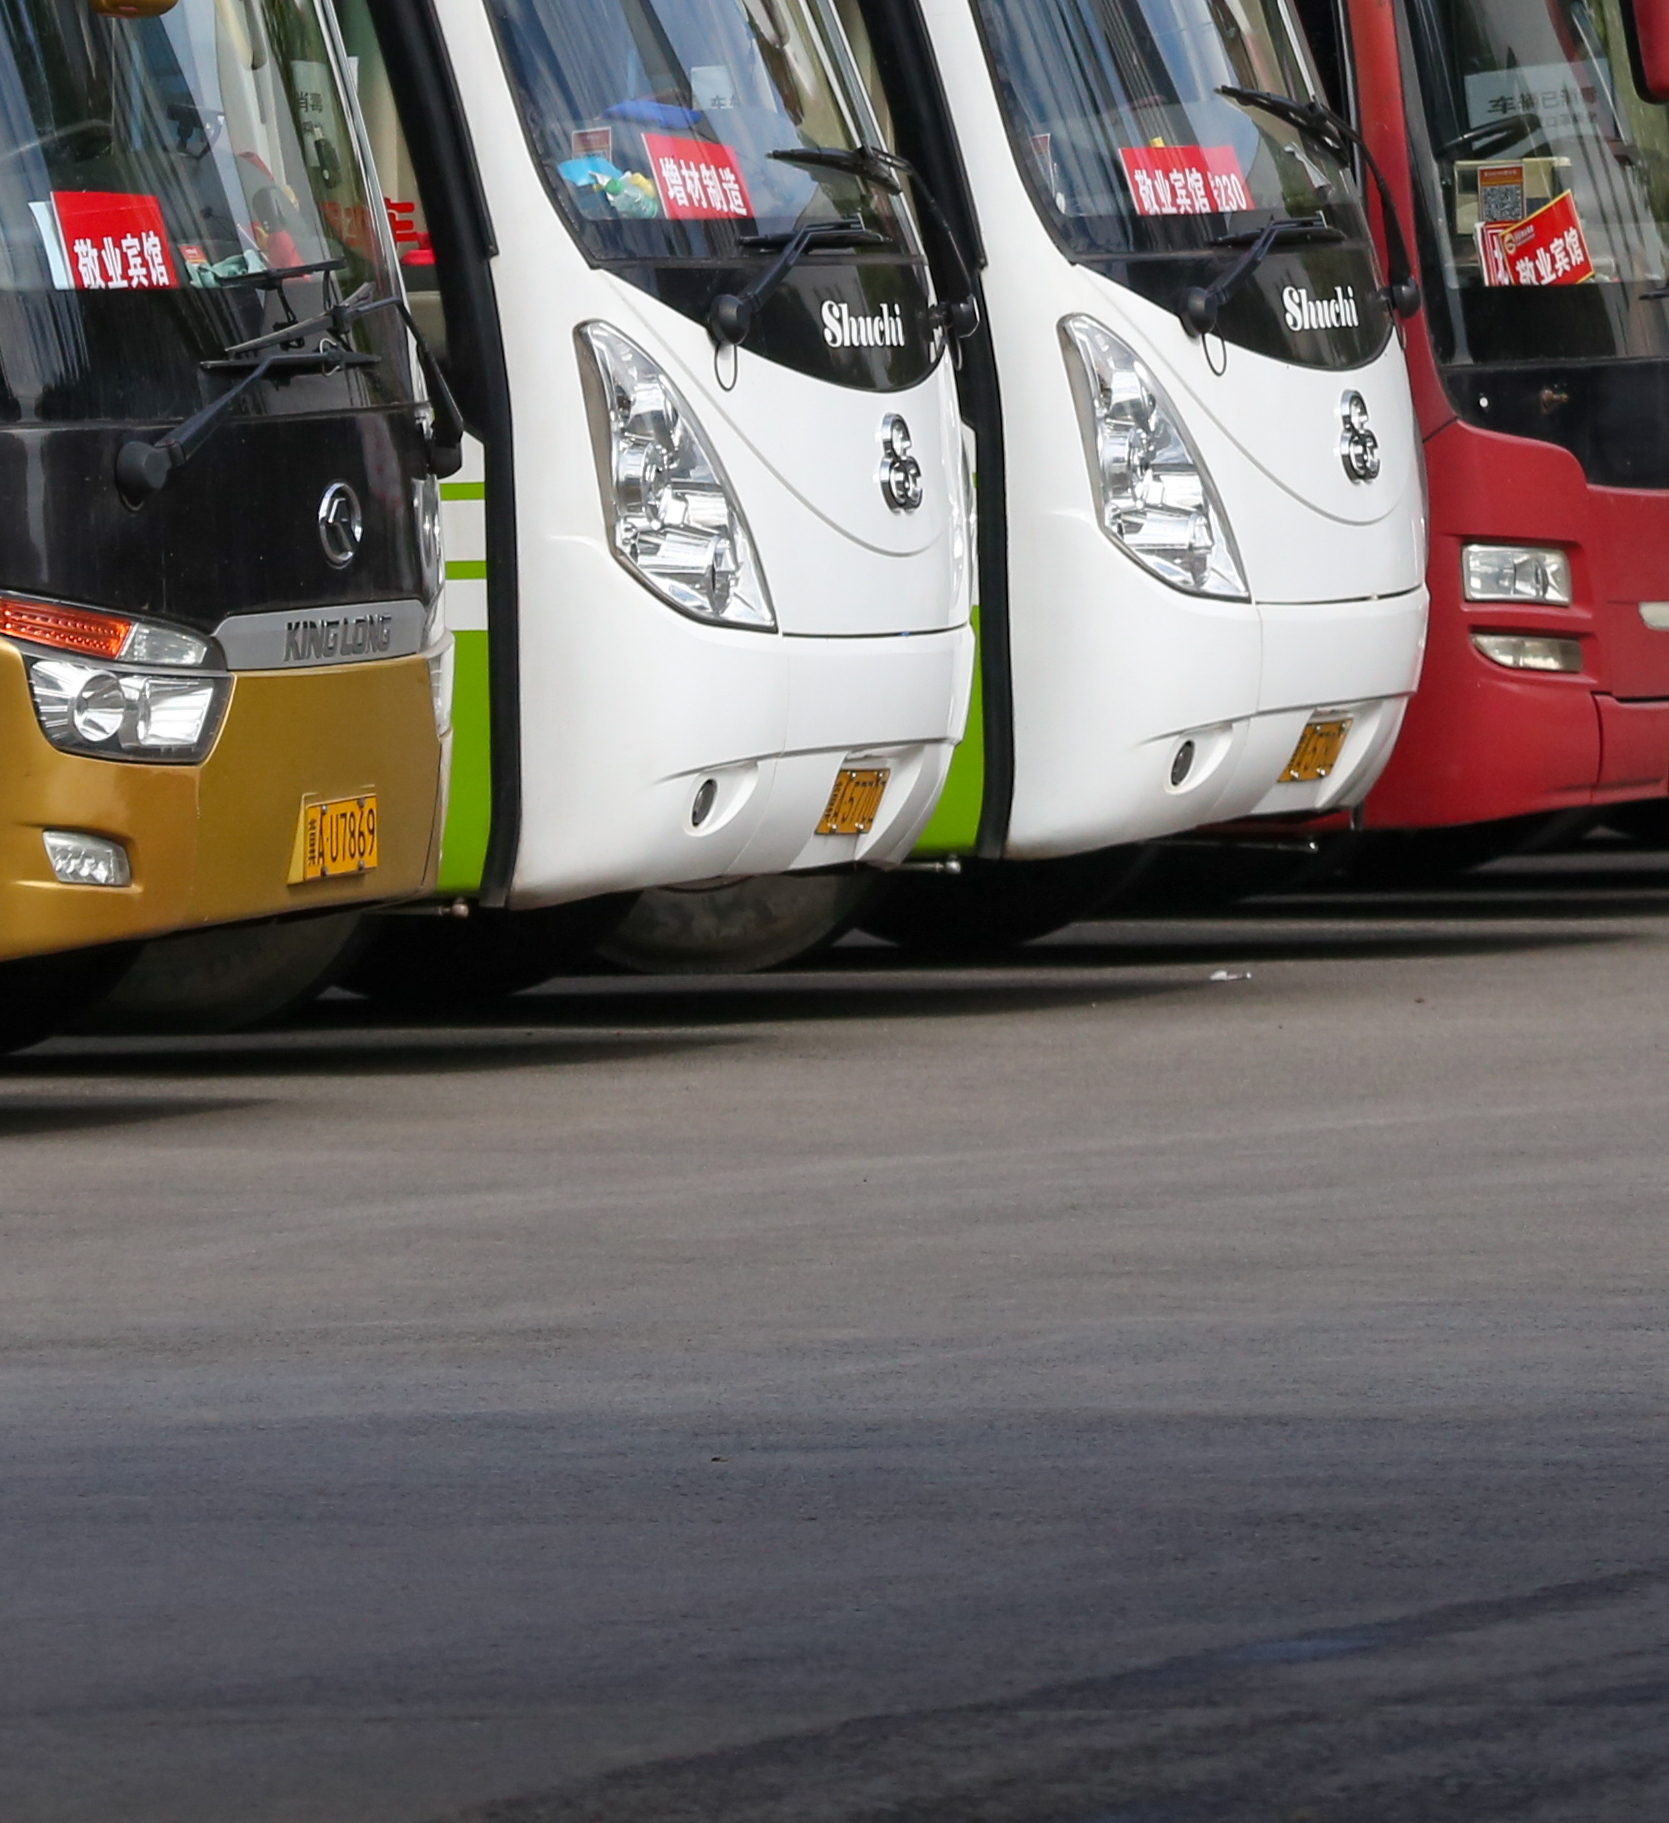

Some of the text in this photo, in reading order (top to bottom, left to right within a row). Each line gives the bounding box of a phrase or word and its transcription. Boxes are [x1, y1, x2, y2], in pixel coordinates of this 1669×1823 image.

[658, 156, 748, 216] 增材制造
[1134, 167, 1211, 215] 敬业宾馆
[73, 229, 170, 290] 敬业宾馆
[1514, 225, 1585, 286] 敬业宾馆
[821, 300, 905, 348] Shuchi
[1282, 285, 1359, 332] Shuchi
